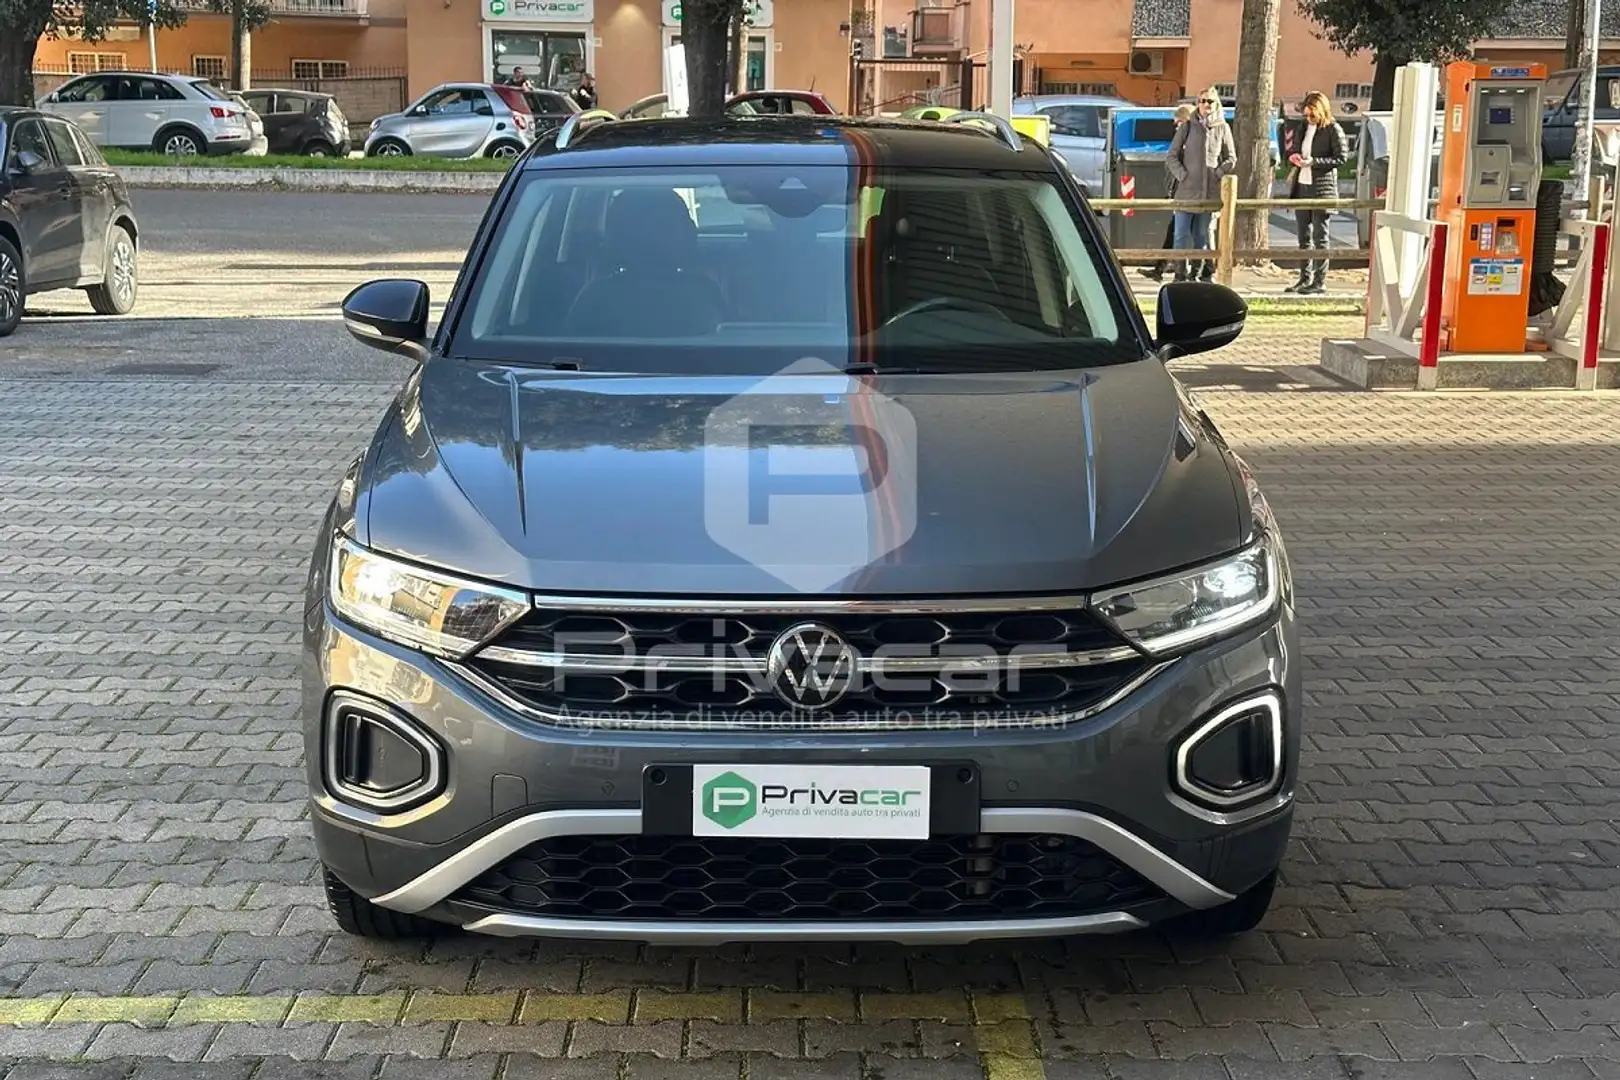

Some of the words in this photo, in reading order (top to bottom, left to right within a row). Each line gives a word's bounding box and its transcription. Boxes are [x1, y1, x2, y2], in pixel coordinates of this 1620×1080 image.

[514, 0, 585, 11] Privacar
[762, 782, 922, 806] Privacar
[762, 807, 801, 817] Agenzia
[802, 807, 812, 816] di
[814, 807, 849, 817] vendita
[851, 808, 872, 817] auto
[874, 808, 888, 817] tra
[891, 809, 921, 819] privati
